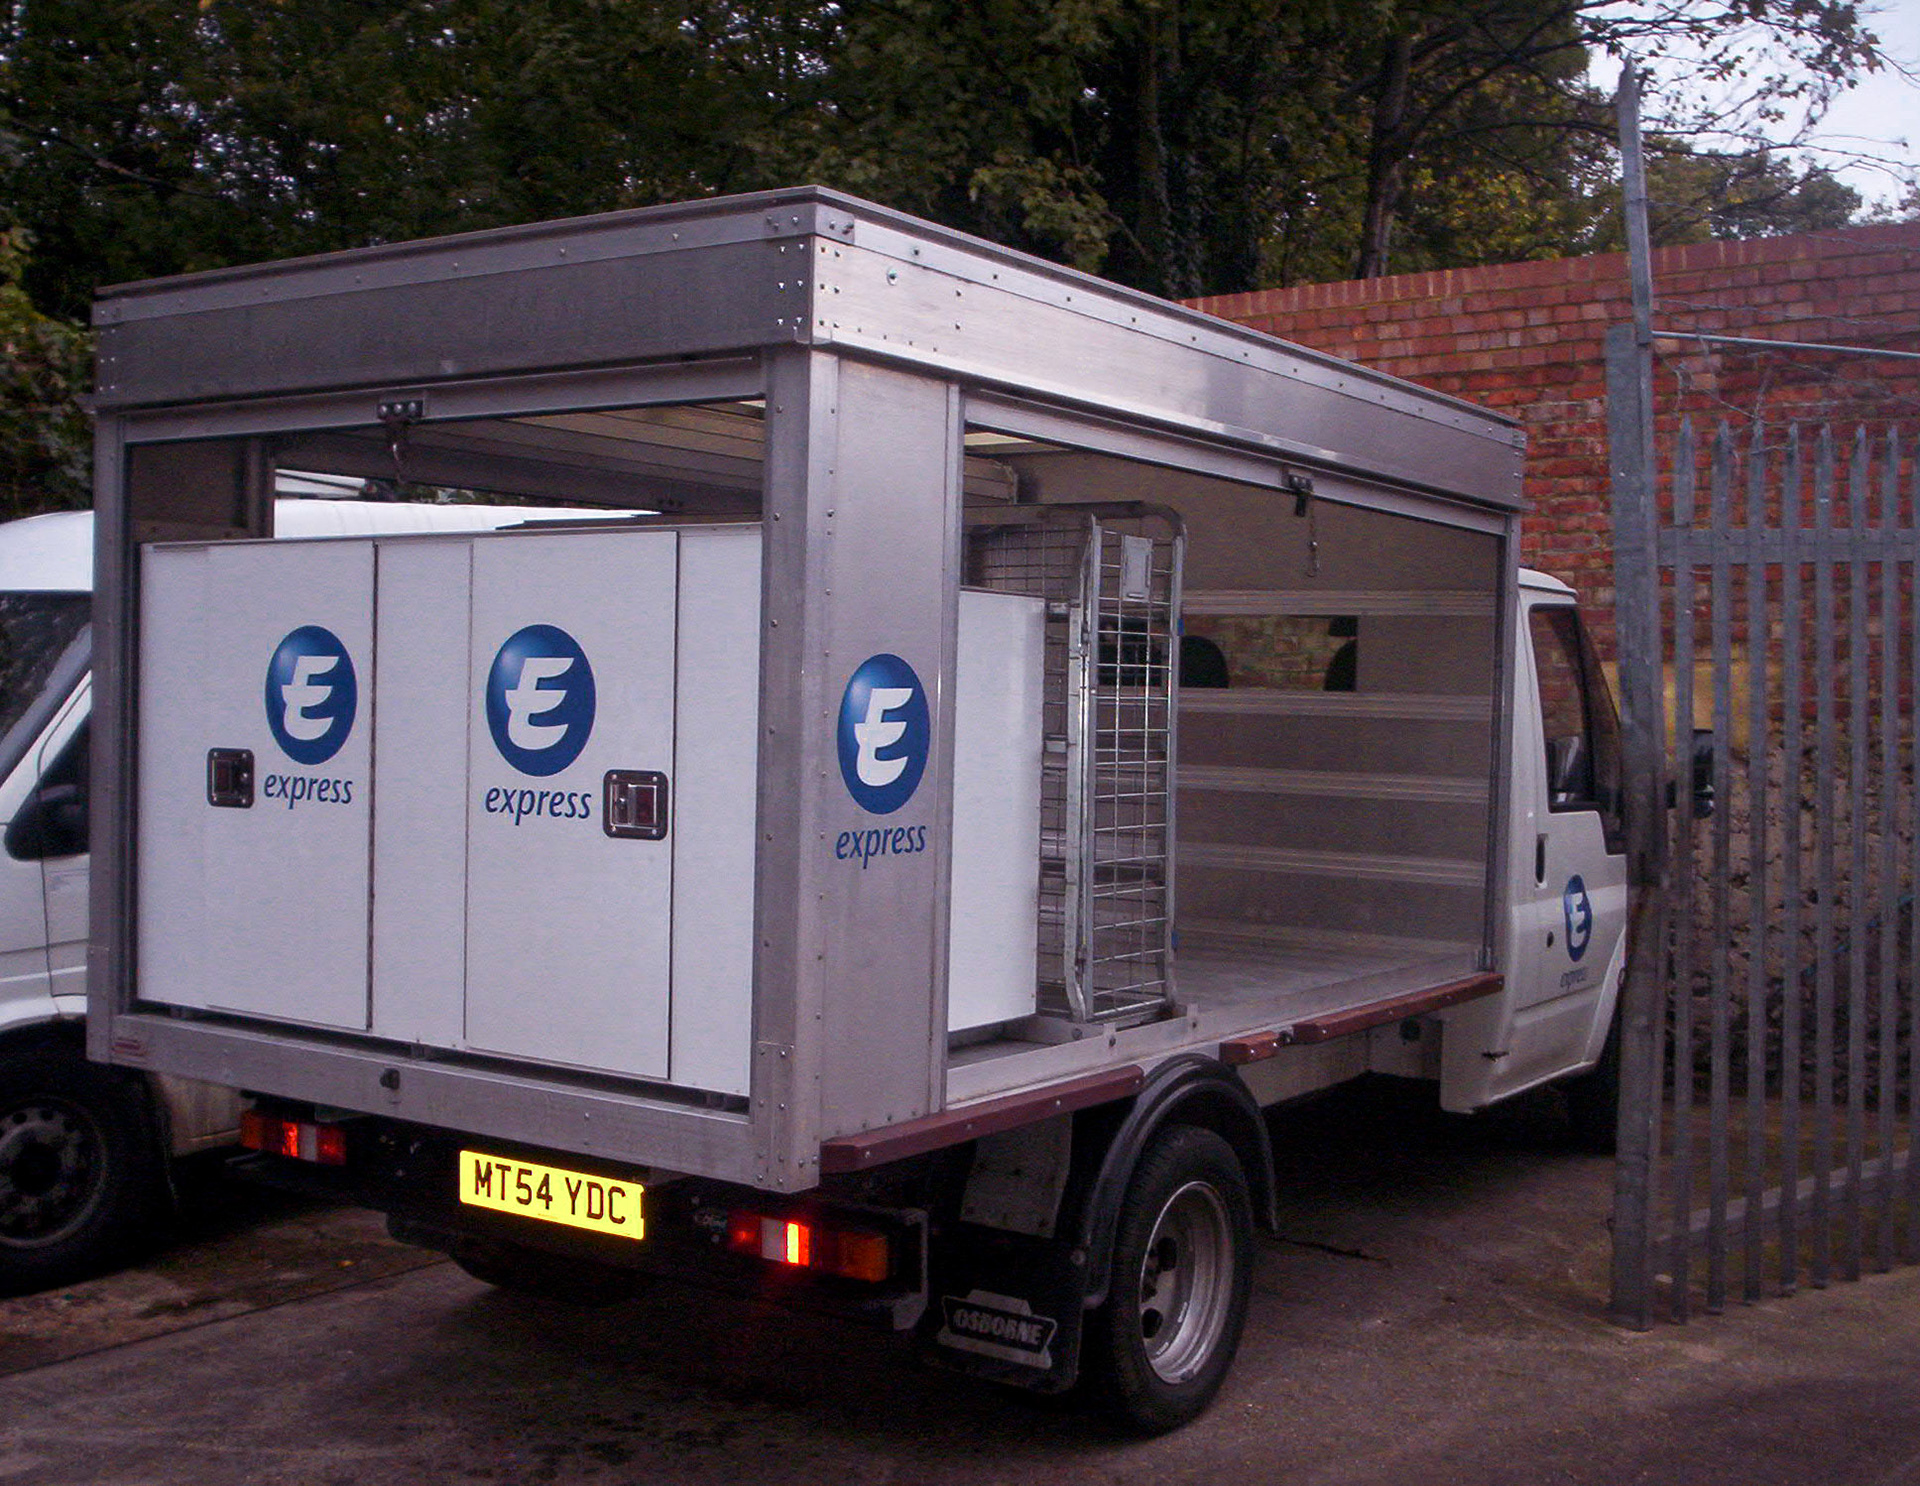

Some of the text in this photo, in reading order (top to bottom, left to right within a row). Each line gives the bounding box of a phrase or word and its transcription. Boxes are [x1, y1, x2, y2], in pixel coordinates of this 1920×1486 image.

[263, 773, 353, 809] express
[485, 787, 592, 826] express
[835, 825, 926, 870] express
[474, 1159, 627, 1225] MT54 YDC
